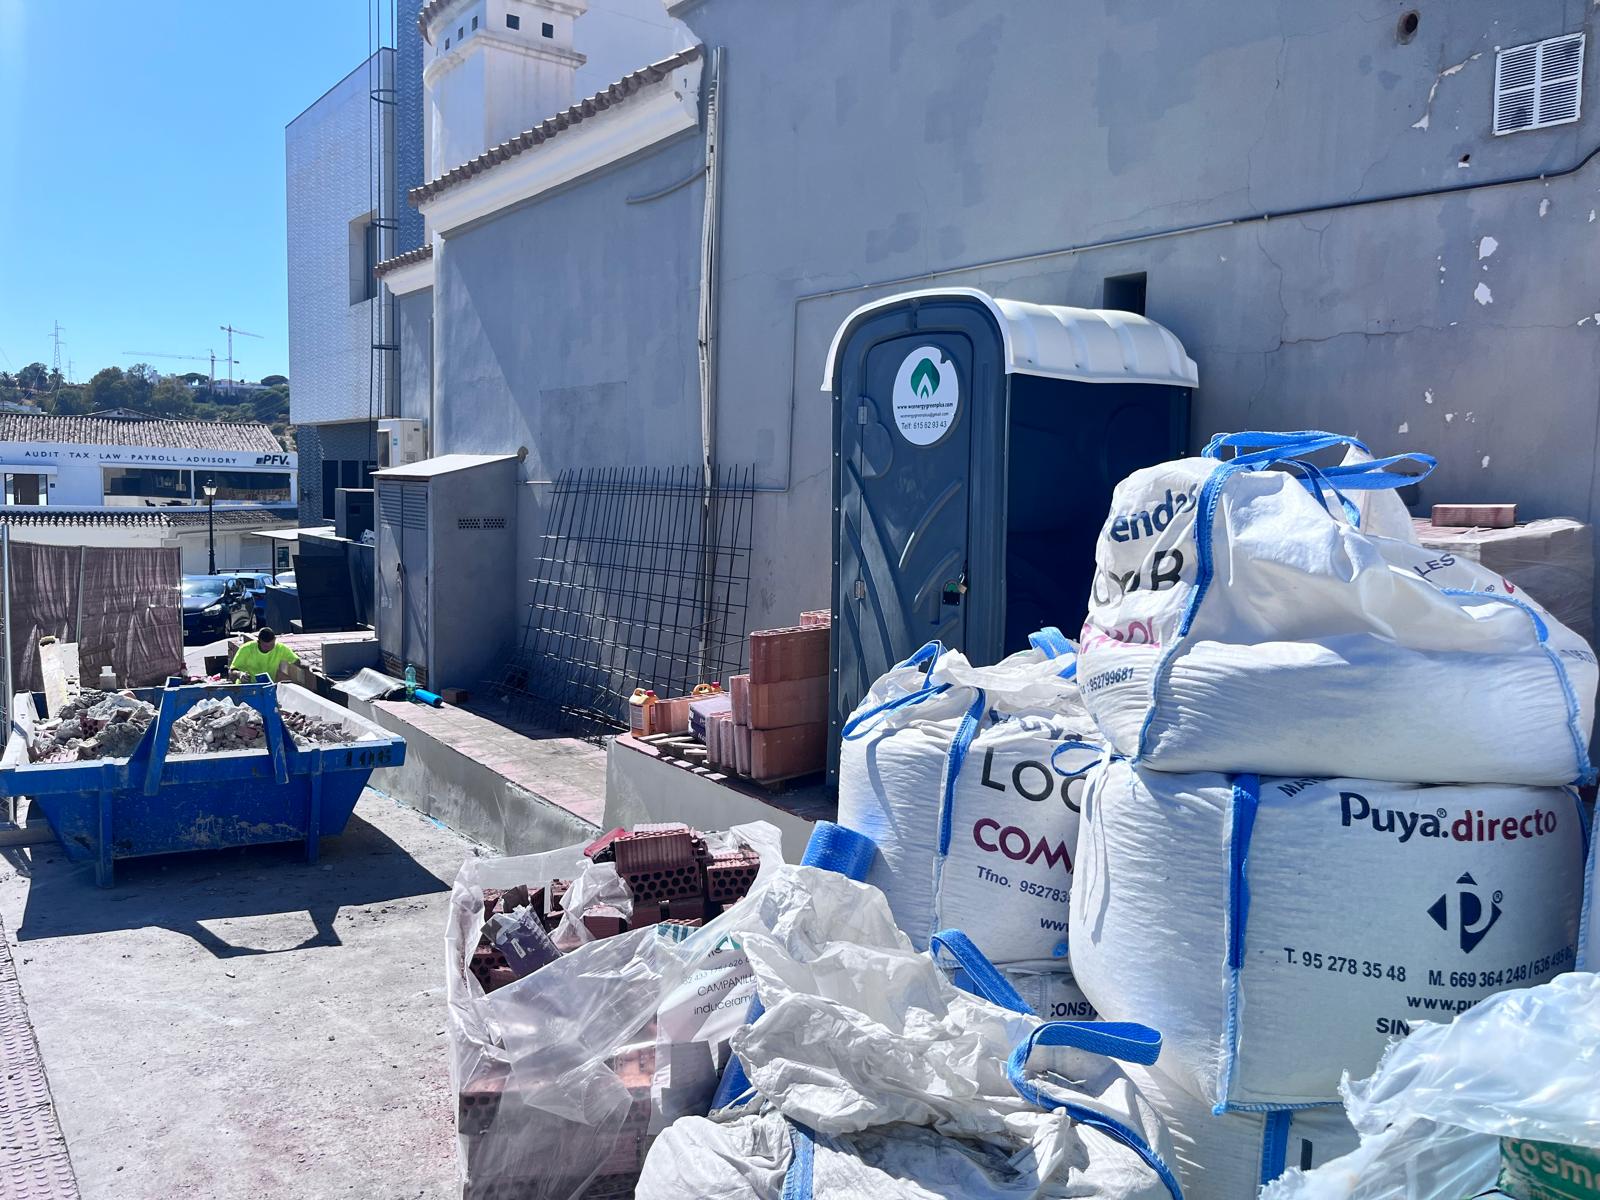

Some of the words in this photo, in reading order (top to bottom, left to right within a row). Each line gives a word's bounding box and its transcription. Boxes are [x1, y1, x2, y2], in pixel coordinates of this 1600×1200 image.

[186, 456, 237, 464] ADVISORY
[973, 818, 1074, 875] COM
[977, 865, 1011, 887] Tfno.
[1019, 880, 1070, 903] 952783
[1284, 947, 1297, 964] T.
[1302, 951, 1323, 968] 95
[1328, 956, 1357, 975] 278
[1362, 961, 1382, 979] 35
[1386, 965, 1406, 982] 48
[1429, 970, 1445, 986] M.
[1450, 972, 1476, 988] 669
[1479, 970, 1503, 987] 364
[1506, 967, 1526, 984] 248
[694, 995, 754, 1015] induceram
[1407, 996, 1480, 1013] www.pu
[1376, 1017, 1410, 1036] SIN
